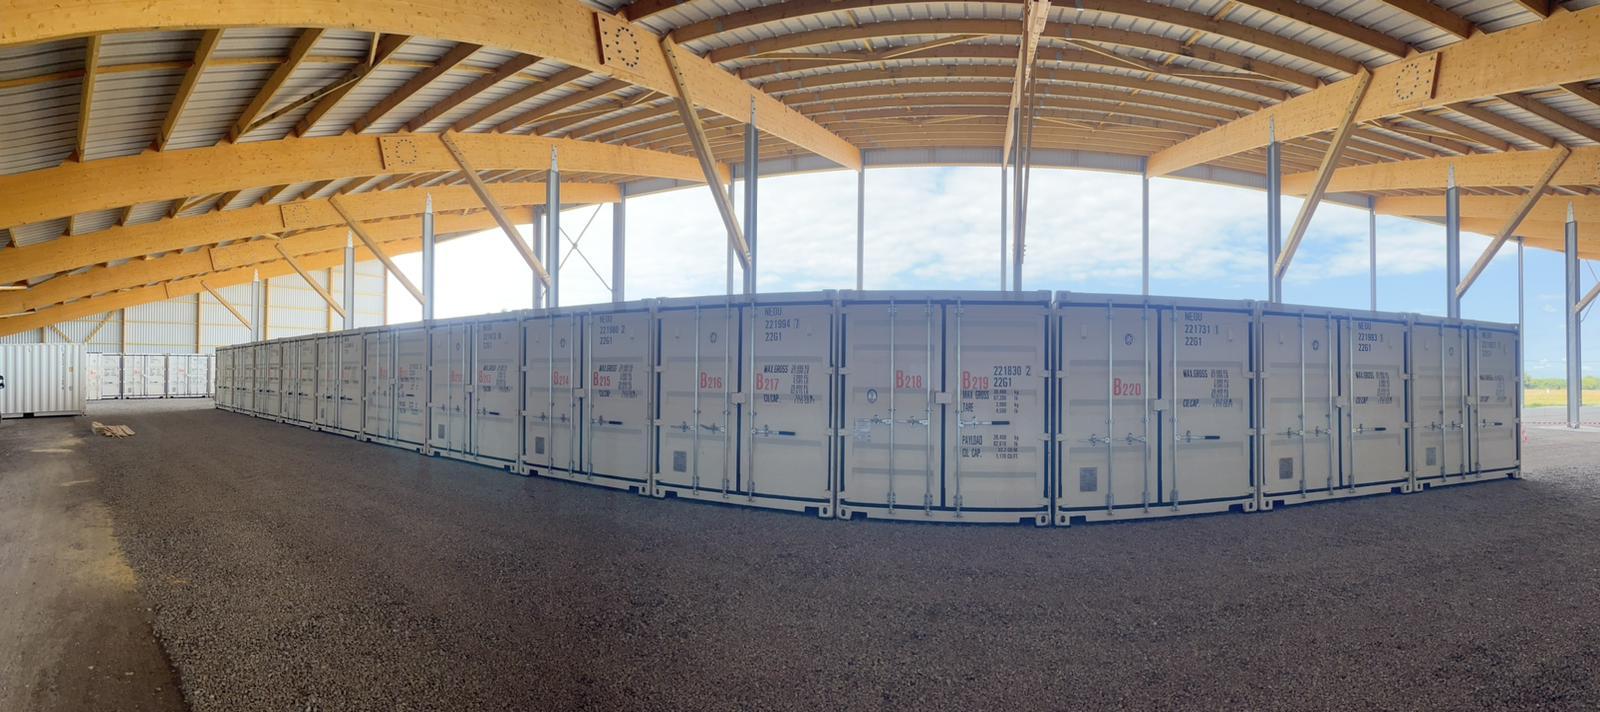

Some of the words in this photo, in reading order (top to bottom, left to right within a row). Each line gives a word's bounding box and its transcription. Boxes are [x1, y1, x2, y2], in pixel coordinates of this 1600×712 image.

[593, 371, 610, 386] B215
[896, 370, 922, 388] B218
[993, 365, 1021, 376] 221830
[1025, 365, 1031, 376] 2
[700, 372, 722, 389] B216
[756, 373, 779, 390] B217
[962, 370, 989, 389] B219
[1113, 378, 1141, 396] B220
